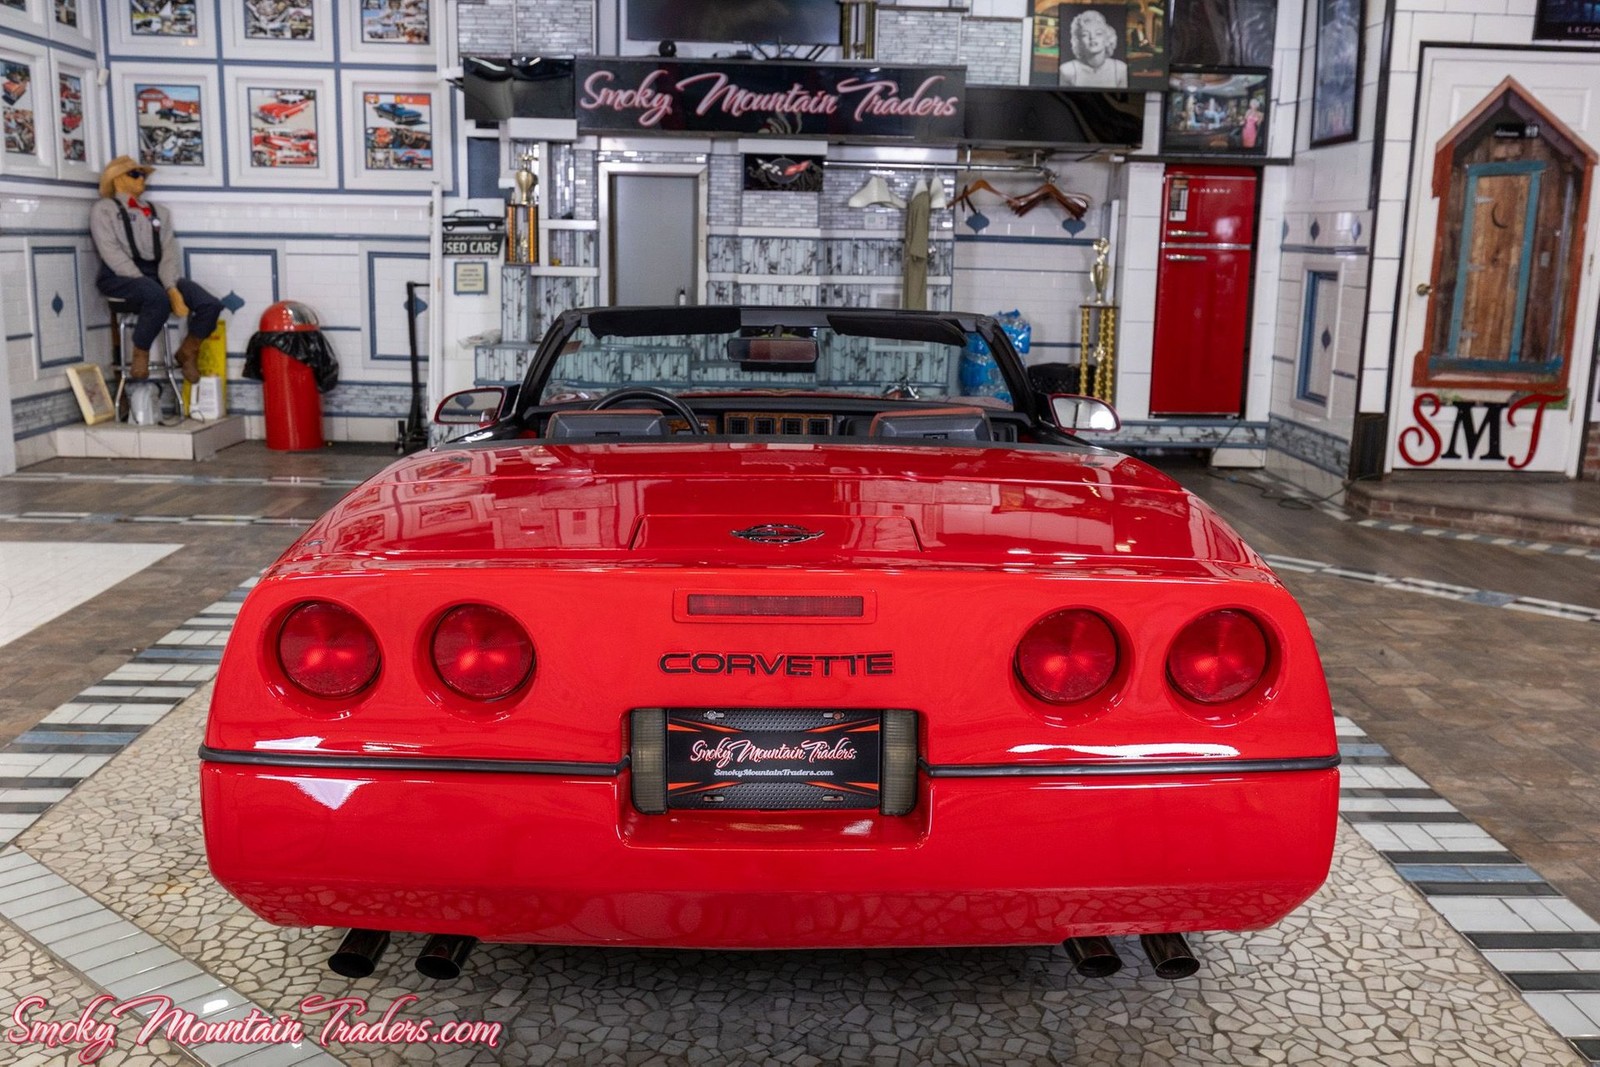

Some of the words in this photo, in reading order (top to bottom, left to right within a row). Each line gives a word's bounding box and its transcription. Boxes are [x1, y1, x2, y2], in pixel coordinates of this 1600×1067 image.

[579, 69, 673, 127] Smoky
[675, 71, 840, 118] Mountain
[837, 75, 959, 122] Traders
[469, 241, 499, 254] CARS
[1397, 392, 1567, 470] SMT
[659, 652, 894, 677] CORVETTE
[689, 736, 734, 769] Smoky
[728, 739, 807, 763] Mountain
[800, 736, 858, 763] Traders
[713, 768, 834, 778] SmokyMountainTraders.com
